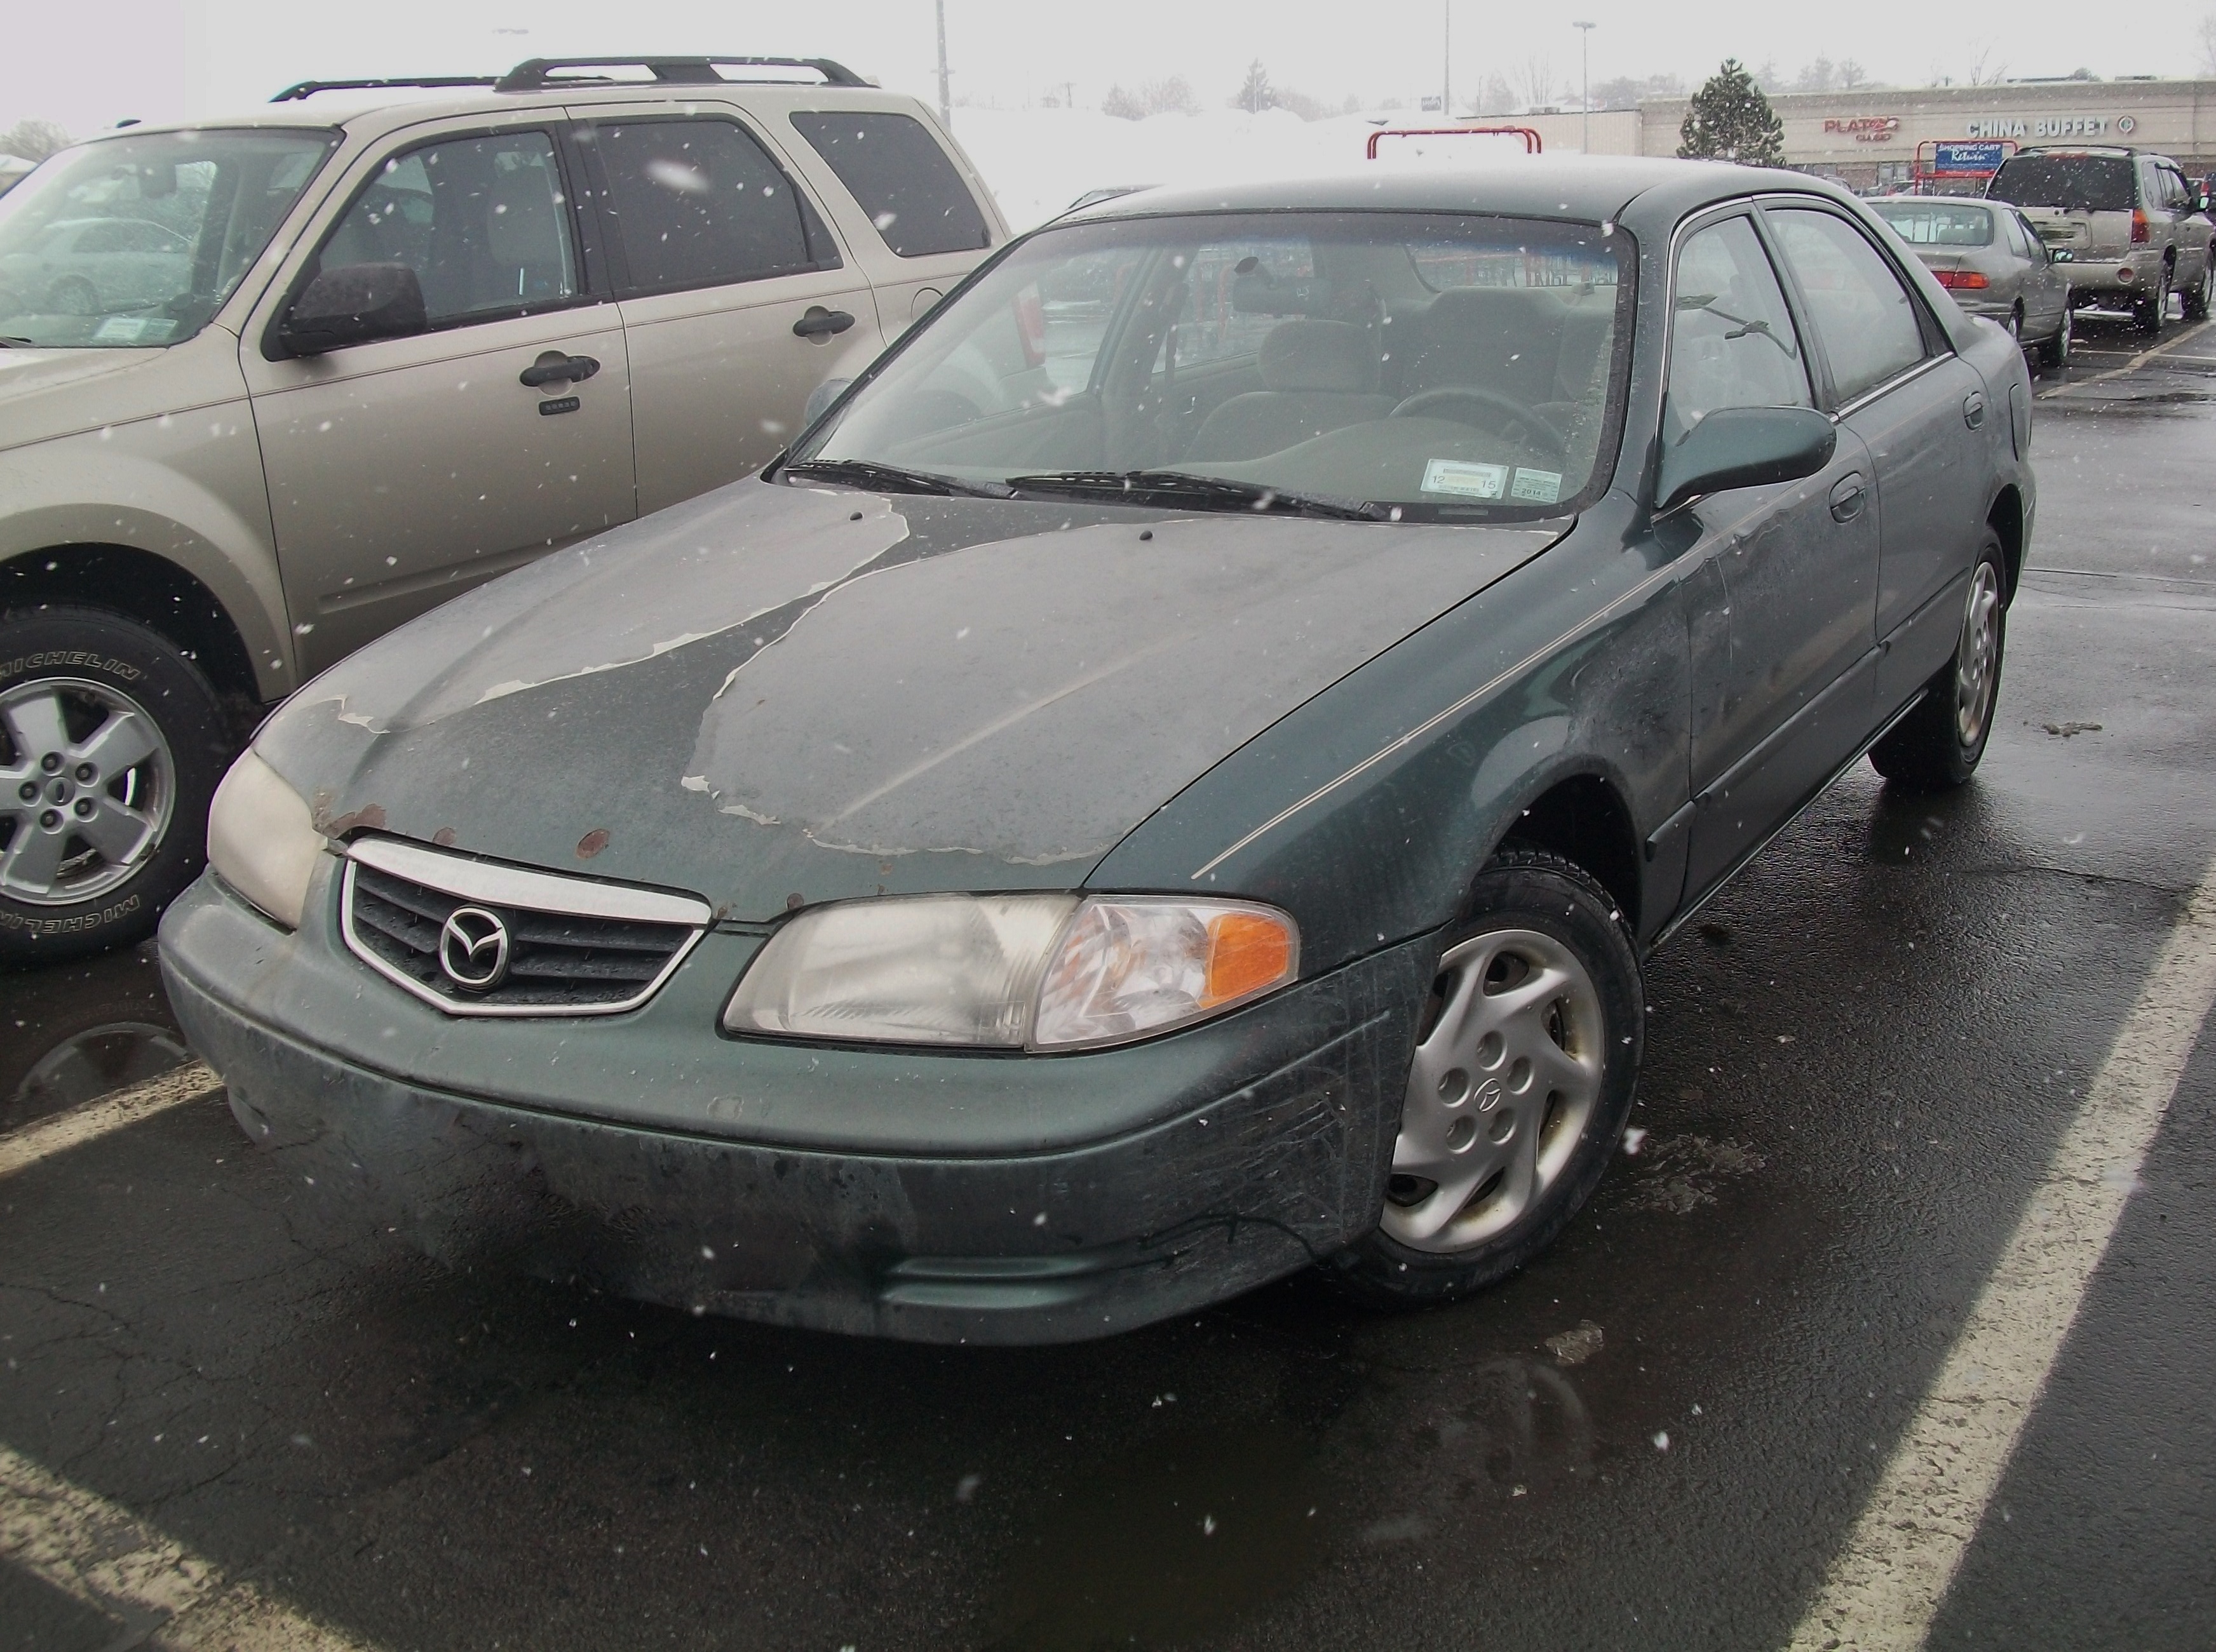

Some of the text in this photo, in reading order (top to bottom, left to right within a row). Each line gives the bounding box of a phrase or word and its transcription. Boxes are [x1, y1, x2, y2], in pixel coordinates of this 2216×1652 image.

[1968, 117, 2109, 138] CHINA BUFFET
[1433, 475, 1496, 489] 12 15
